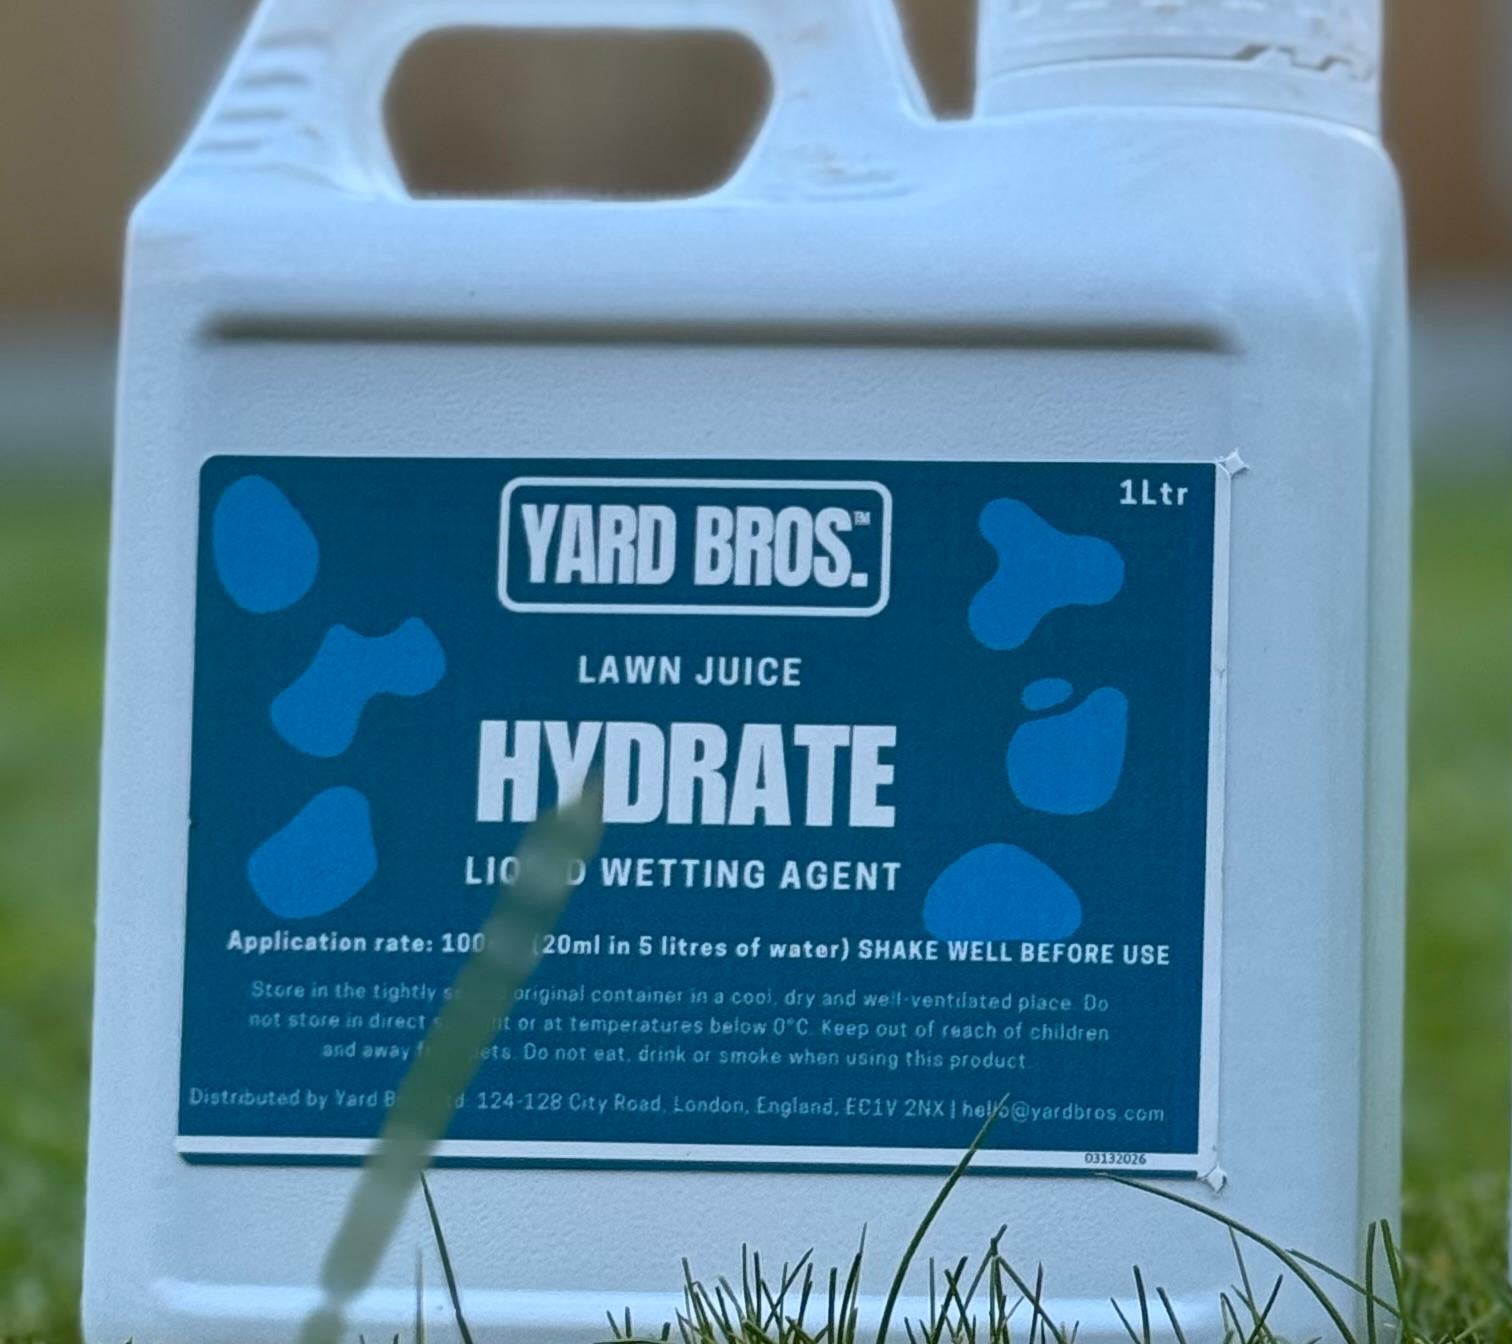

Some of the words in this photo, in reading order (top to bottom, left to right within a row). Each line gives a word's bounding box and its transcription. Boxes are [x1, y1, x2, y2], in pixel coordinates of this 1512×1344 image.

[1119, 479, 1189, 505] 1Ltr
[521, 504, 677, 584] YARD
[578, 655, 681, 685] LAWN
[695, 657, 802, 686] JUICE
[476, 719, 897, 827] HYDRATE
[465, 856, 587, 887] LIQD
[601, 858, 766, 889] WETTING
[780, 861, 901, 891] AGENT
[226, 929, 367, 955] Application
[373, 931, 433, 953] rate:
[607, 935, 631, 956] in
[638, 936, 653, 957] 5
[661, 936, 728, 958] litres
[735, 937, 761, 958] of
[769, 938, 849, 963] water)
[858, 939, 940, 961] SHAKE
[946, 941, 1013, 963] WELL
[1020, 942, 1115, 964] BEFORE
[1121, 944, 1171, 965] USE
[250, 981, 305, 998] Store
[310, 981, 328, 998] in
[334, 982, 366, 999] the
[372, 982, 436, 1003] tightly
[512, 985, 585, 1006] original
[590, 986, 682, 1004] container
[689, 987, 708, 1004] in
[712, 991, 724, 1004] a
[783, 989, 816, 1009] dry
[821, 990, 856, 1006] and
[862, 990, 1013, 1009] well-ventilated
[1083, 994, 1109, 1011] Do
[249, 1010, 281, 1027] not
[287, 1010, 340, 1028] store
[345, 1011, 363, 1029] in
[368, 1011, 426, 1030] direct
[517, 1017, 537, 1031] or
[542, 1014, 563, 1032] at
[569, 1015, 703, 1037] temperatures
[709, 1017, 768, 1035] below
[820, 1019, 869, 1040] Keep
[875, 1019, 907, 1037] out
[914, 1020, 935, 1038] of
[941, 1020, 997, 1039] reach
[1002, 1021, 1023, 1039] of
[1029, 1022, 1109, 1040] children
[321, 1039, 357, 1057] and
[361, 1044, 410, 1061] away
[522, 1042, 549, 1060] Do
[554, 1043, 587, 1061] not
[637, 1044, 686, 1062] drink
[691, 1050, 710, 1063] or
[718, 1046, 781, 1064] smoke
[788, 1047, 840, 1065] when
[845, 1048, 899, 1069] using
[904, 1049, 943, 1067] this
[189, 1086, 300, 1106] Distributed
[305, 1088, 328, 1110] by
[334, 1089, 378, 1107] Yard
[475, 1091, 563, 1111] 124-128
[568, 1093, 608, 1115] City
[845, 1098, 898, 1117] EC1V
[903, 1099, 945, 1118] 2NX
[1084, 1152, 1147, 1164] 03132026
